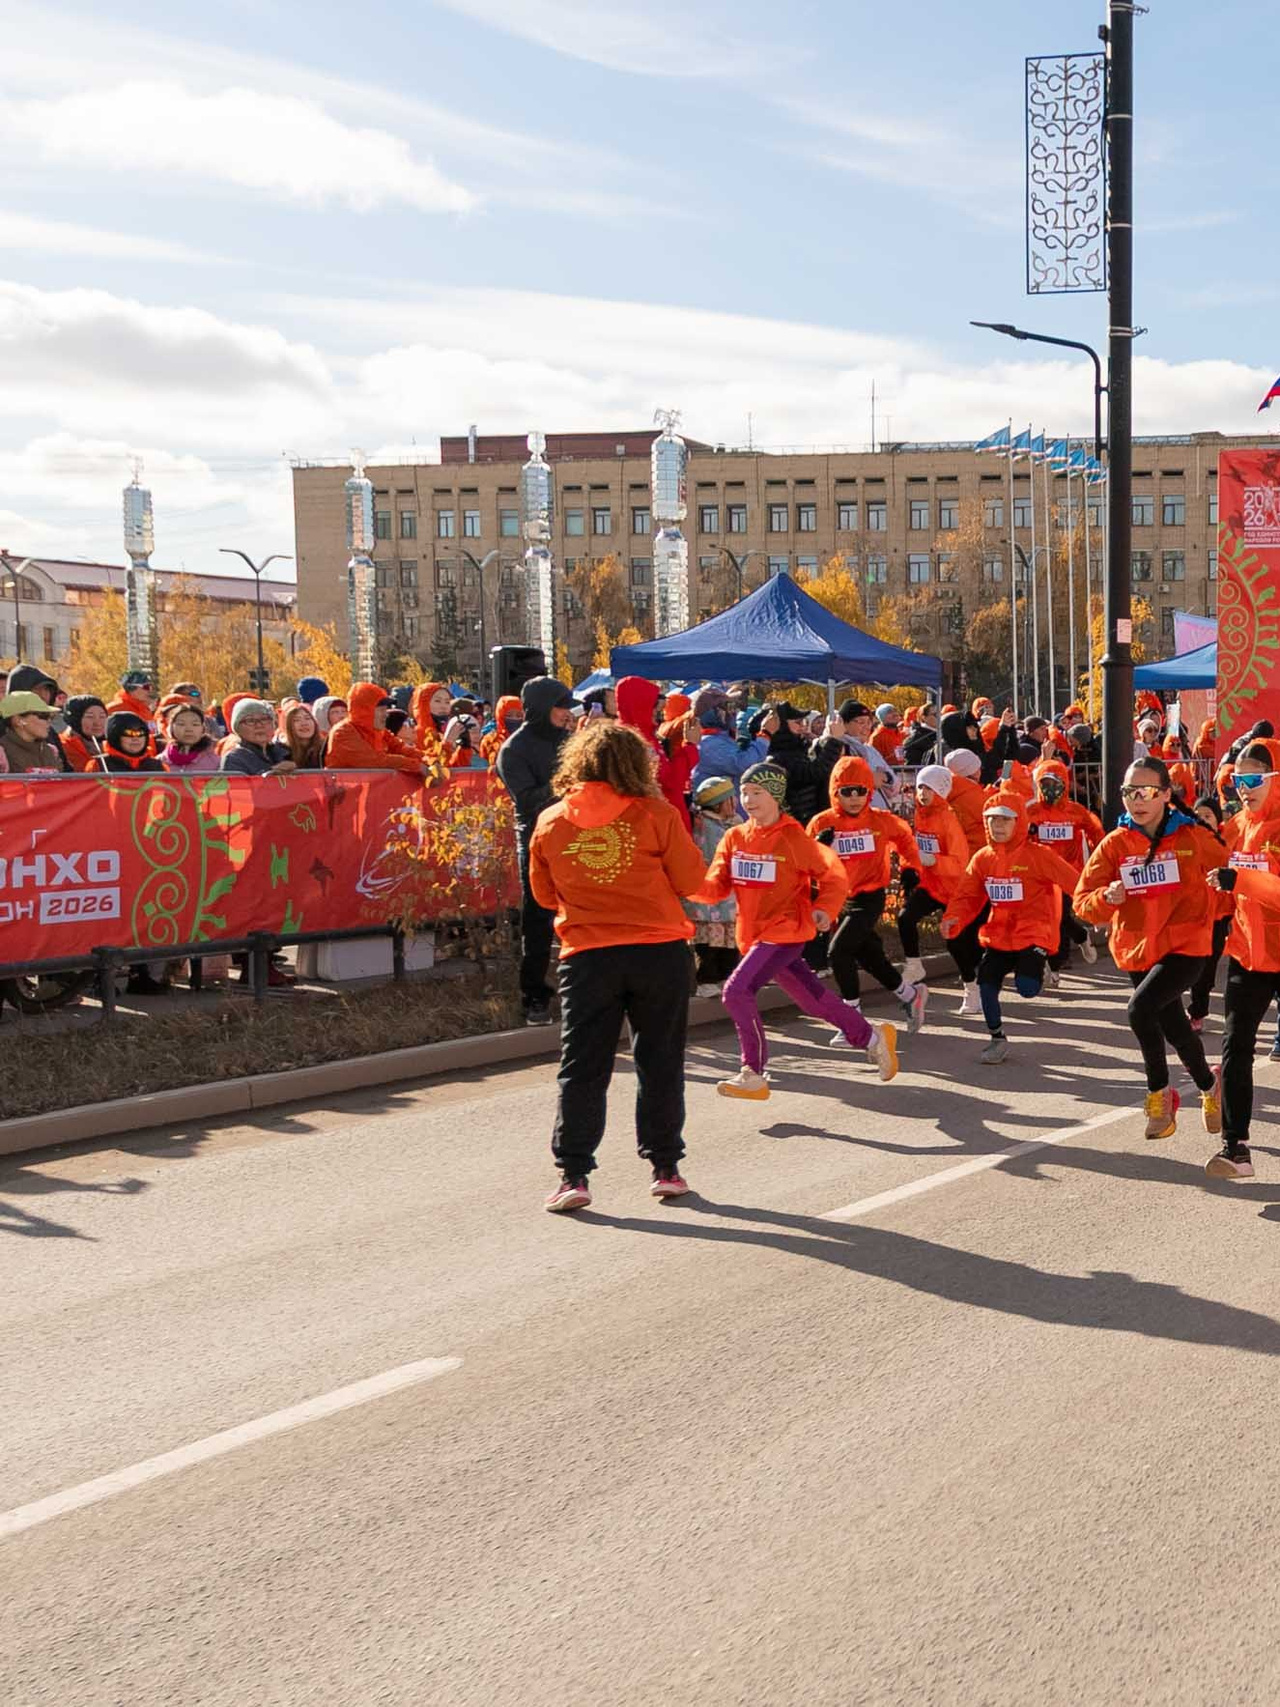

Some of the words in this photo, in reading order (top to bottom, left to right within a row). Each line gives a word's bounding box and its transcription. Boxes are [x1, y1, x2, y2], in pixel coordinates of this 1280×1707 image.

[1046, 827, 1067, 839] 1434
[838, 837, 865, 854] 0049
[0, 850, 121, 890] НХО
[737, 861, 764, 879] 0067
[1130, 863, 1166, 886] 0068
[989, 885, 1013, 900] 0036
[46, 894, 114, 917] 2026
